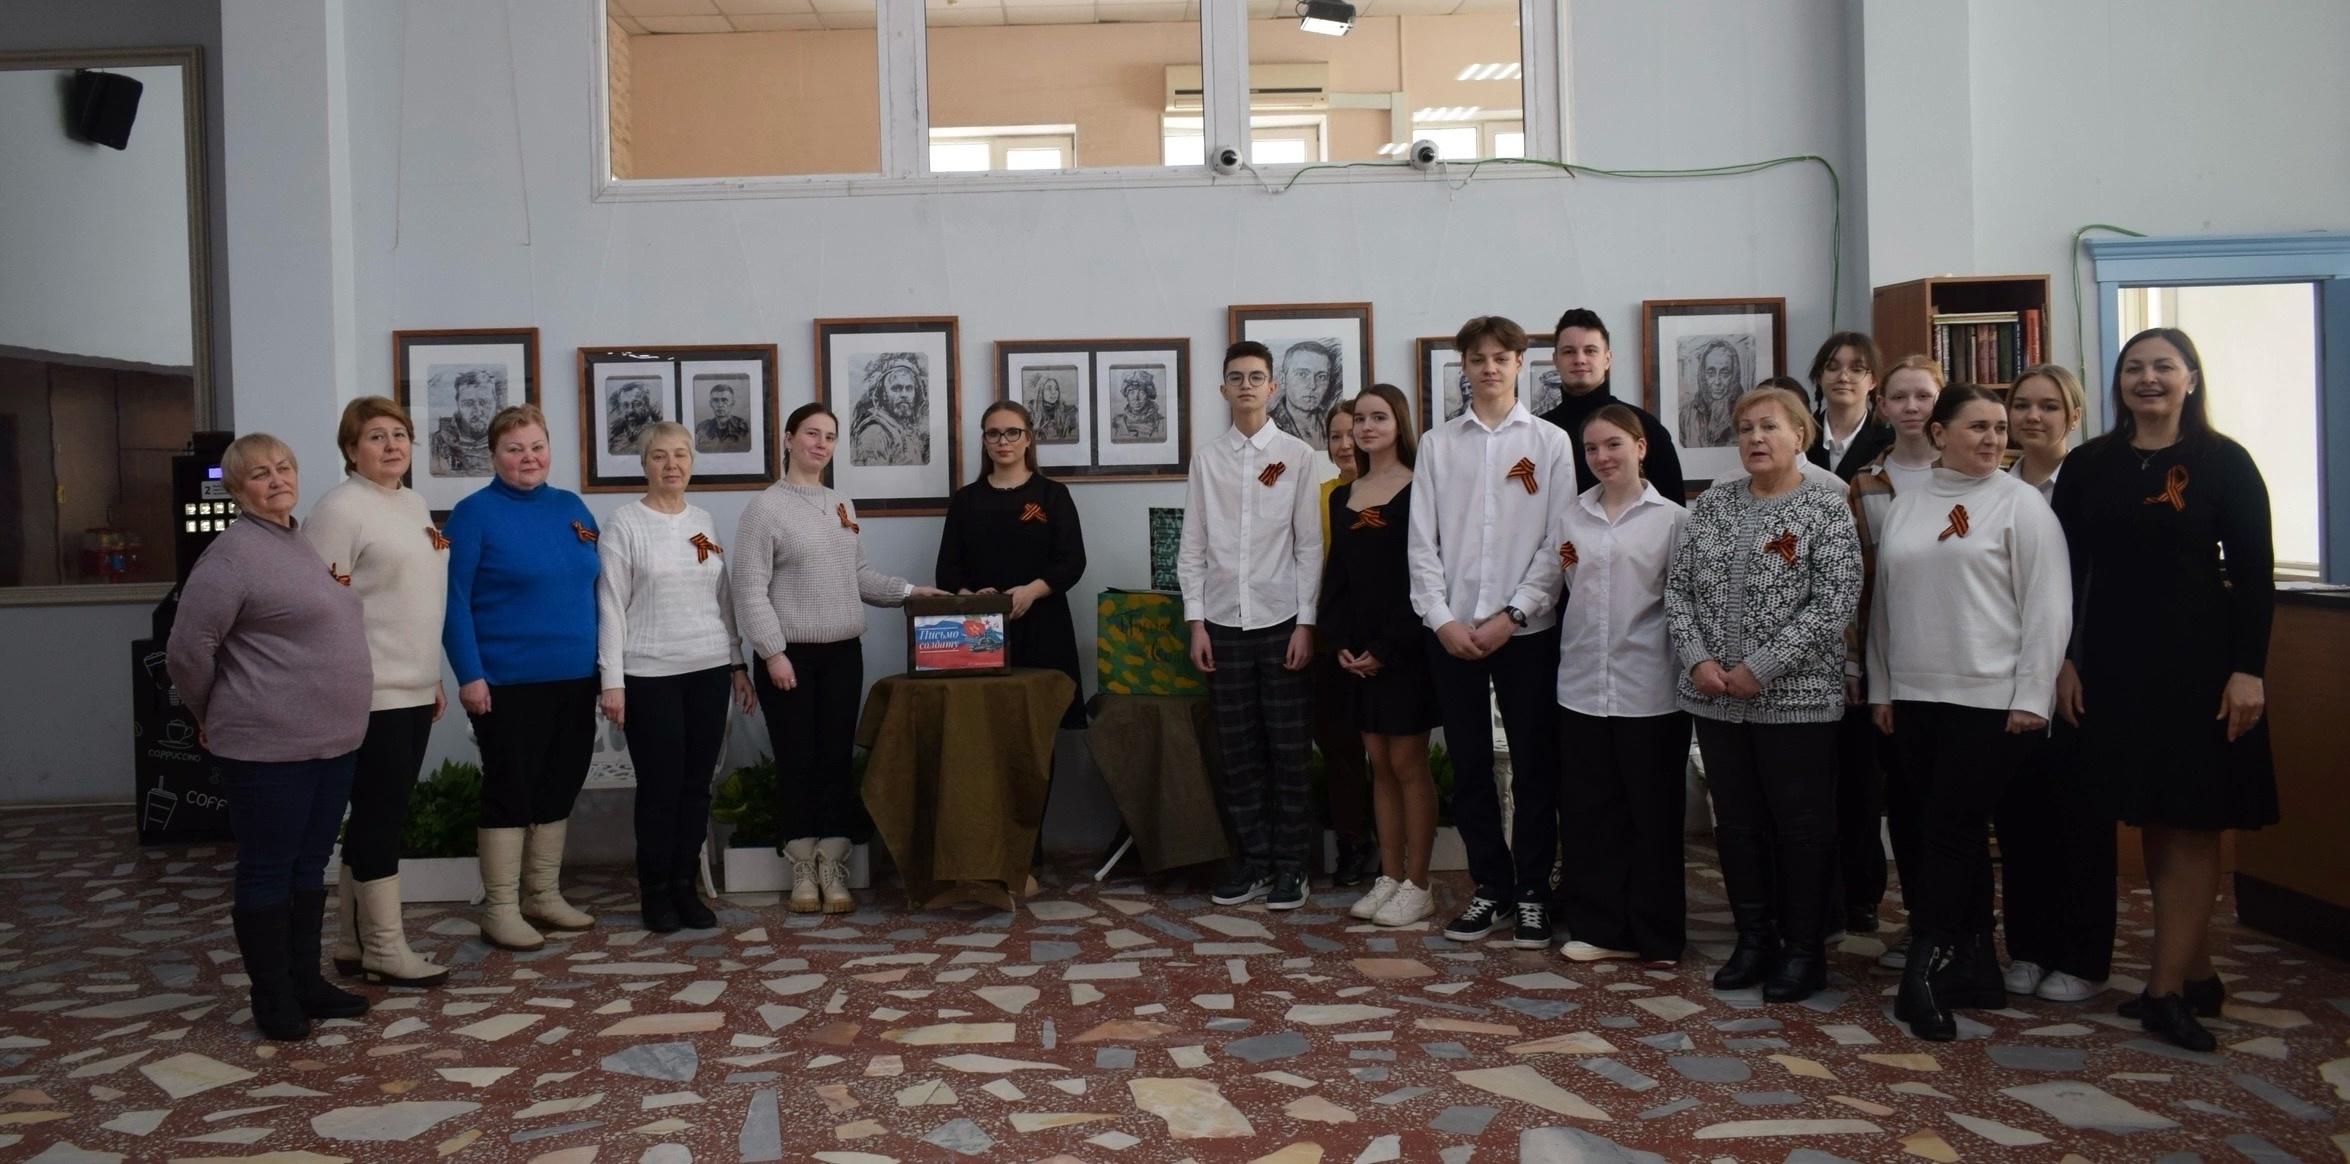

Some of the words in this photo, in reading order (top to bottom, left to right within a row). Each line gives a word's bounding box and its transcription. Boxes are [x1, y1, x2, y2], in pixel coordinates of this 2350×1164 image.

[205, 486, 211, 495] 2
[920, 629, 959, 640] Письмо
[919, 640, 960, 650] солдату
